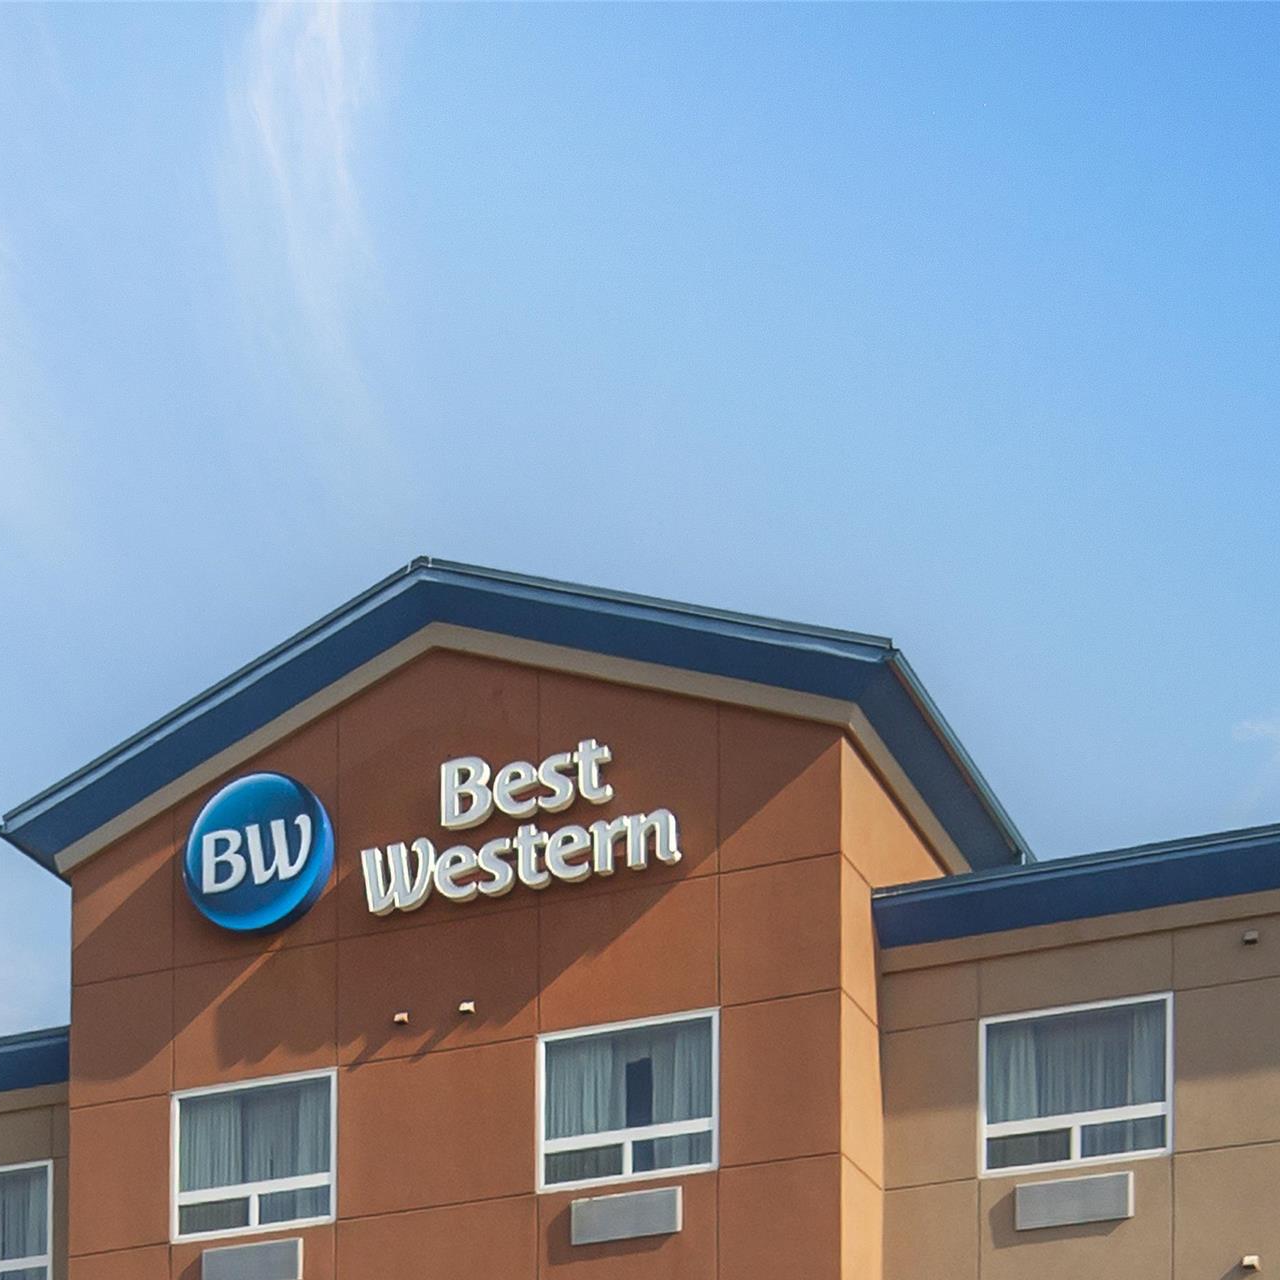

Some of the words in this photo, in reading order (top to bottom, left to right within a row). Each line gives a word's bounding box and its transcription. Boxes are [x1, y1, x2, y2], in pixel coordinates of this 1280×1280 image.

[440, 738, 614, 830] Best
[202, 813, 313, 894] BW
[361, 808, 683, 916] Western
